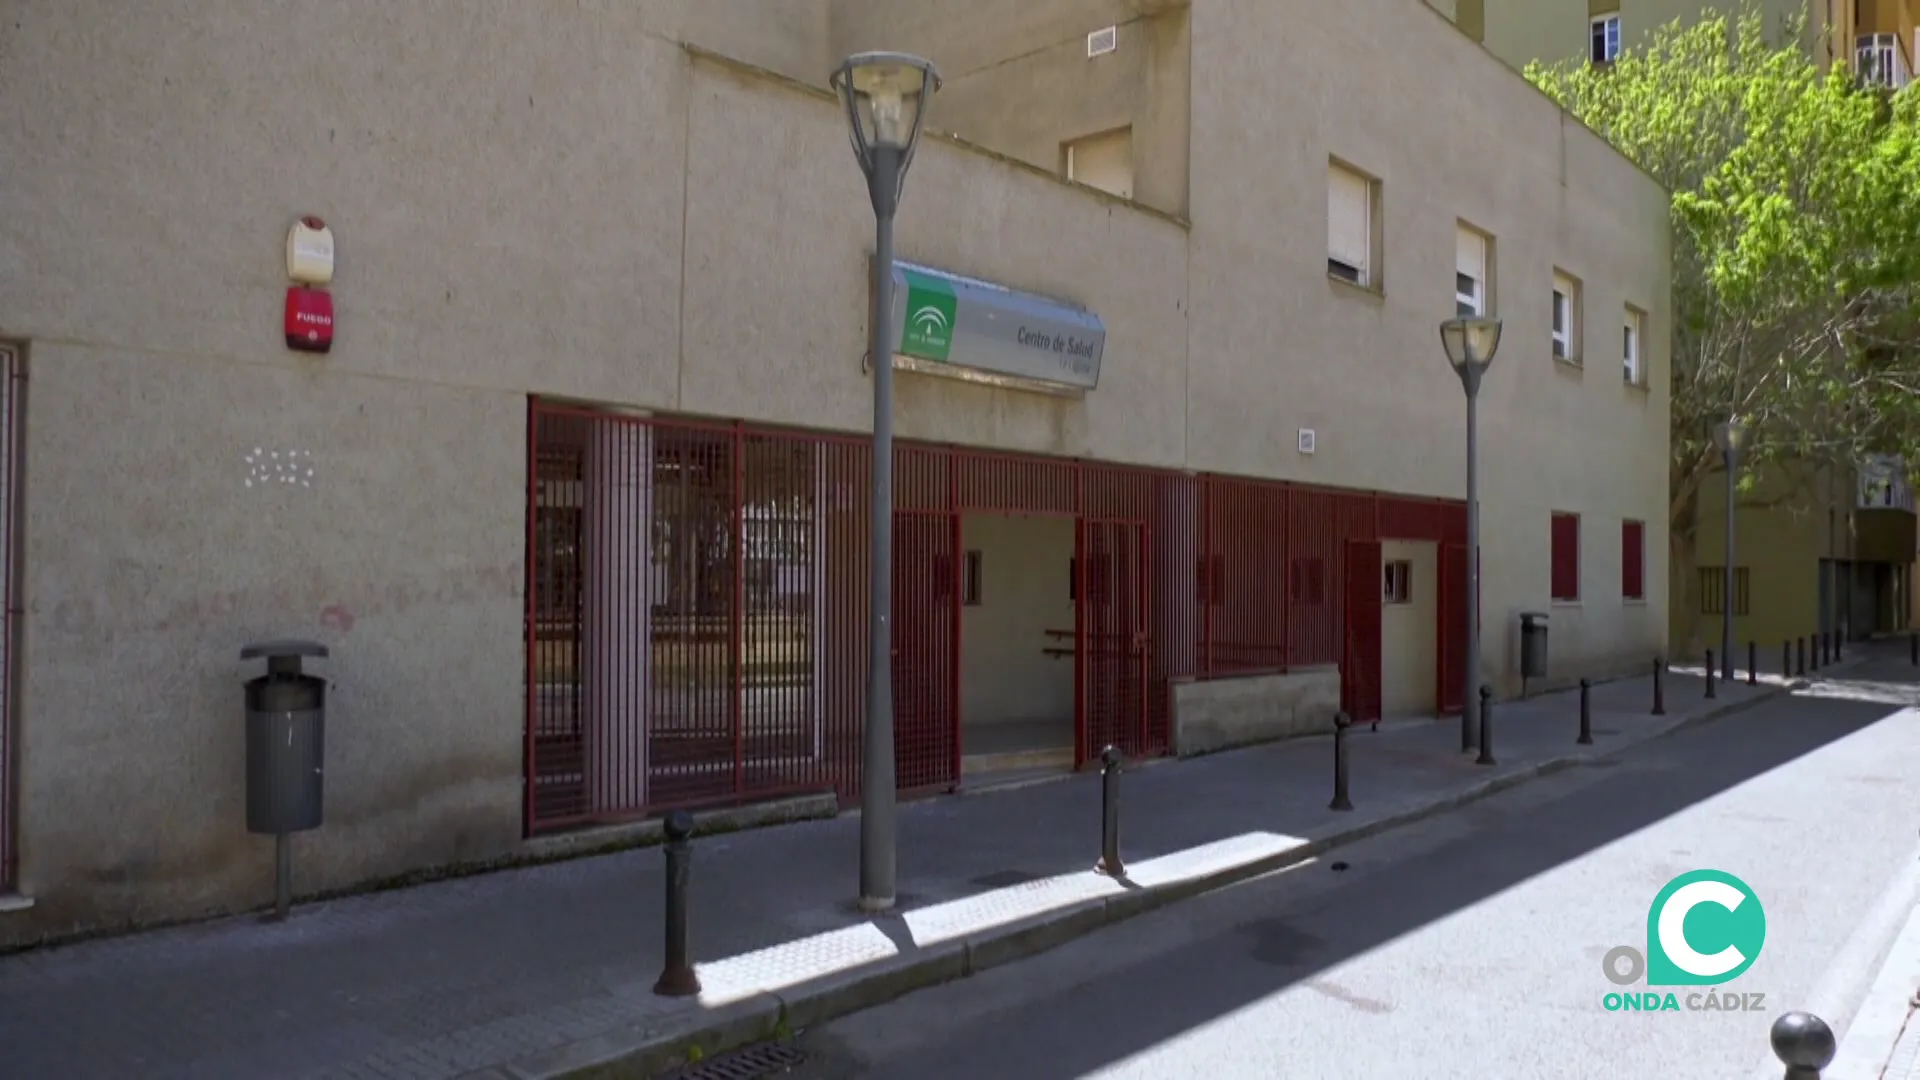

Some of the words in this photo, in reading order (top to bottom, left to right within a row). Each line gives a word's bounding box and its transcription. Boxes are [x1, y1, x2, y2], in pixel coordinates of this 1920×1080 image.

[297, 312, 331, 325] FUEGO
[1017, 325, 1050, 350] Centro
[1052, 333, 1065, 353] de
[1067, 336, 1094, 360] Salud
